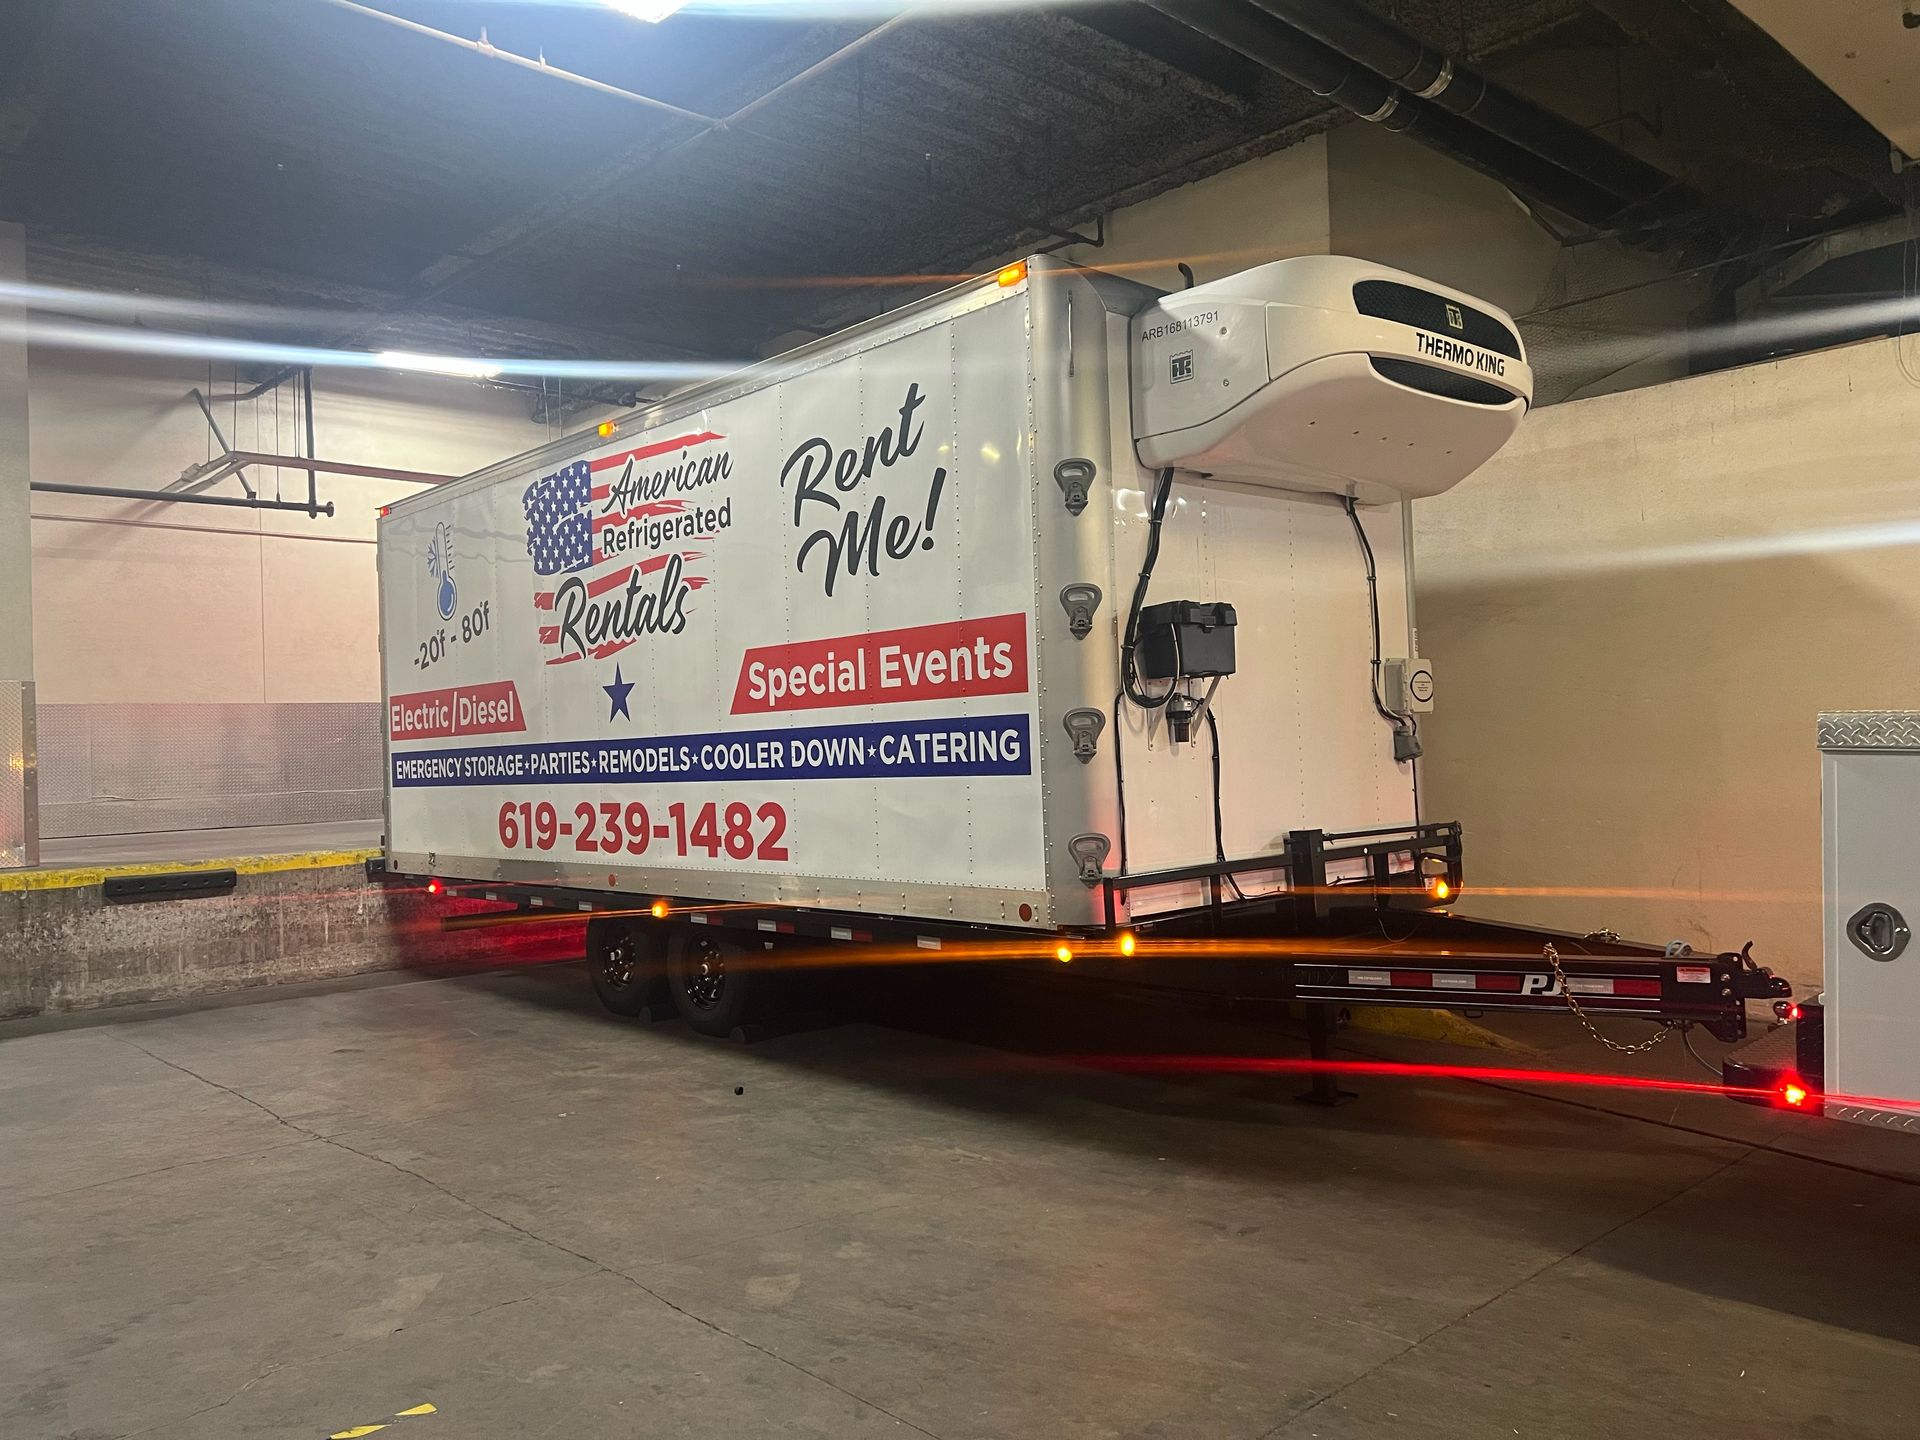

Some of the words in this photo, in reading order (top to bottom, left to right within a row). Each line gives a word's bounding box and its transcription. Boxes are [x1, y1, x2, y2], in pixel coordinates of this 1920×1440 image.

[1142, 310, 1218, 342] ARB168113791
[1416, 332, 1474, 366] THERMO
[1476, 351, 1505, 377] KING
[601, 450, 734, 515] American
[780, 382, 926, 527] Rent
[603, 497, 731, 555] Refrigerated
[796, 467, 947, 597] Me!
[554, 553, 689, 660] Rentals
[748, 648, 866, 707] Special
[879, 636, 1013, 688] Events
[396, 757, 462, 780] EMERGENCY
[464, 754, 524, 778] STORAGE
[530, 751, 591, 775] PARTIES
[599, 747, 690, 773] REMODELS
[700, 741, 784, 770] COOLER
[791, 737, 865, 768] DOWN
[879, 729, 1021, 765] CATERING
[498, 801, 789, 862] 619-239-1482
